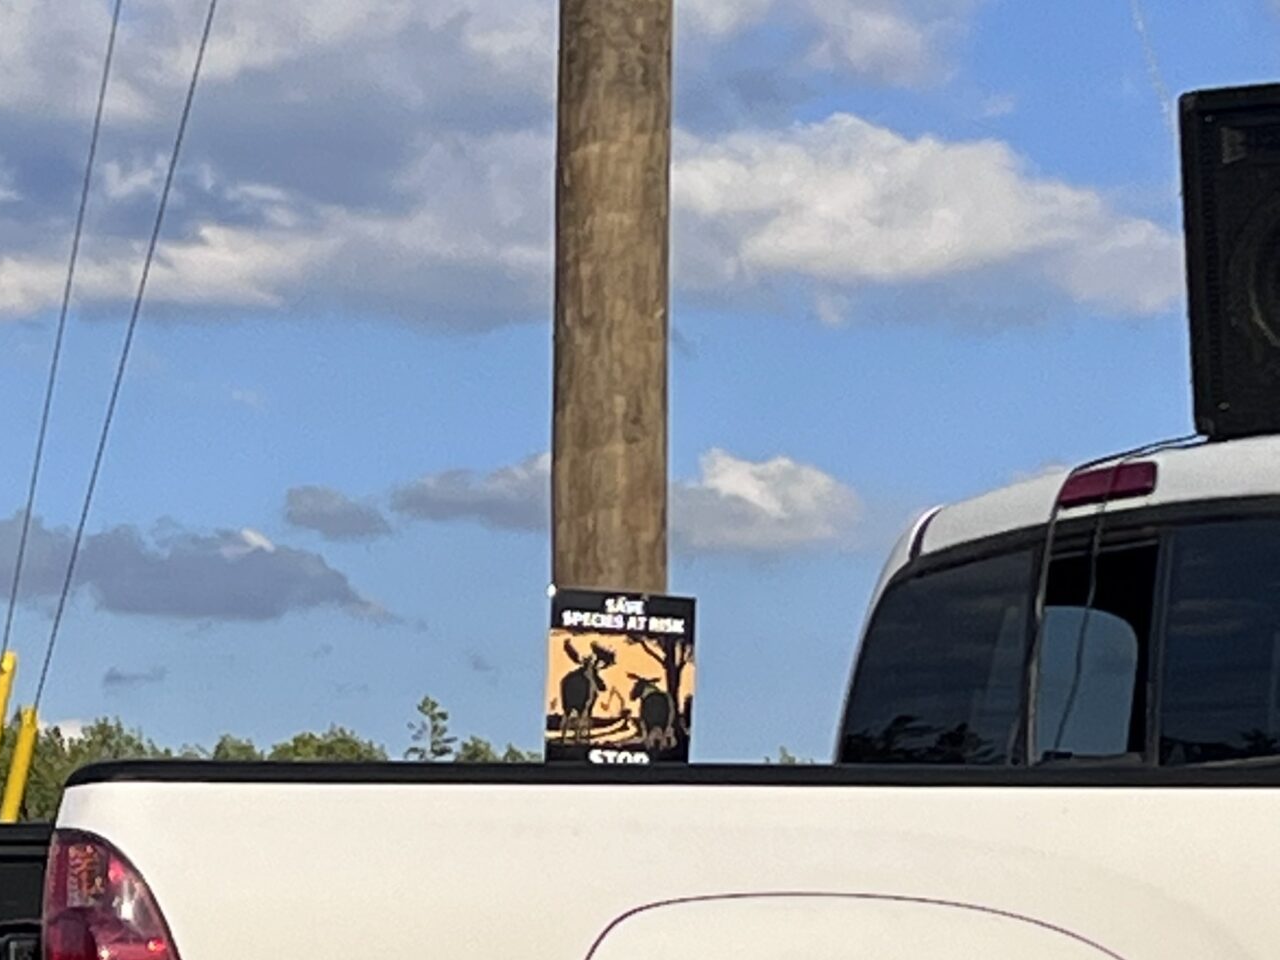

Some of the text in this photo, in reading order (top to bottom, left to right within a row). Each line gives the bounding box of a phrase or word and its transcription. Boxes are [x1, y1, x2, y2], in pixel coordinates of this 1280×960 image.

[605, 597, 644, 614] SAVE
[561, 610, 684, 633] SPECIES AT RISK
